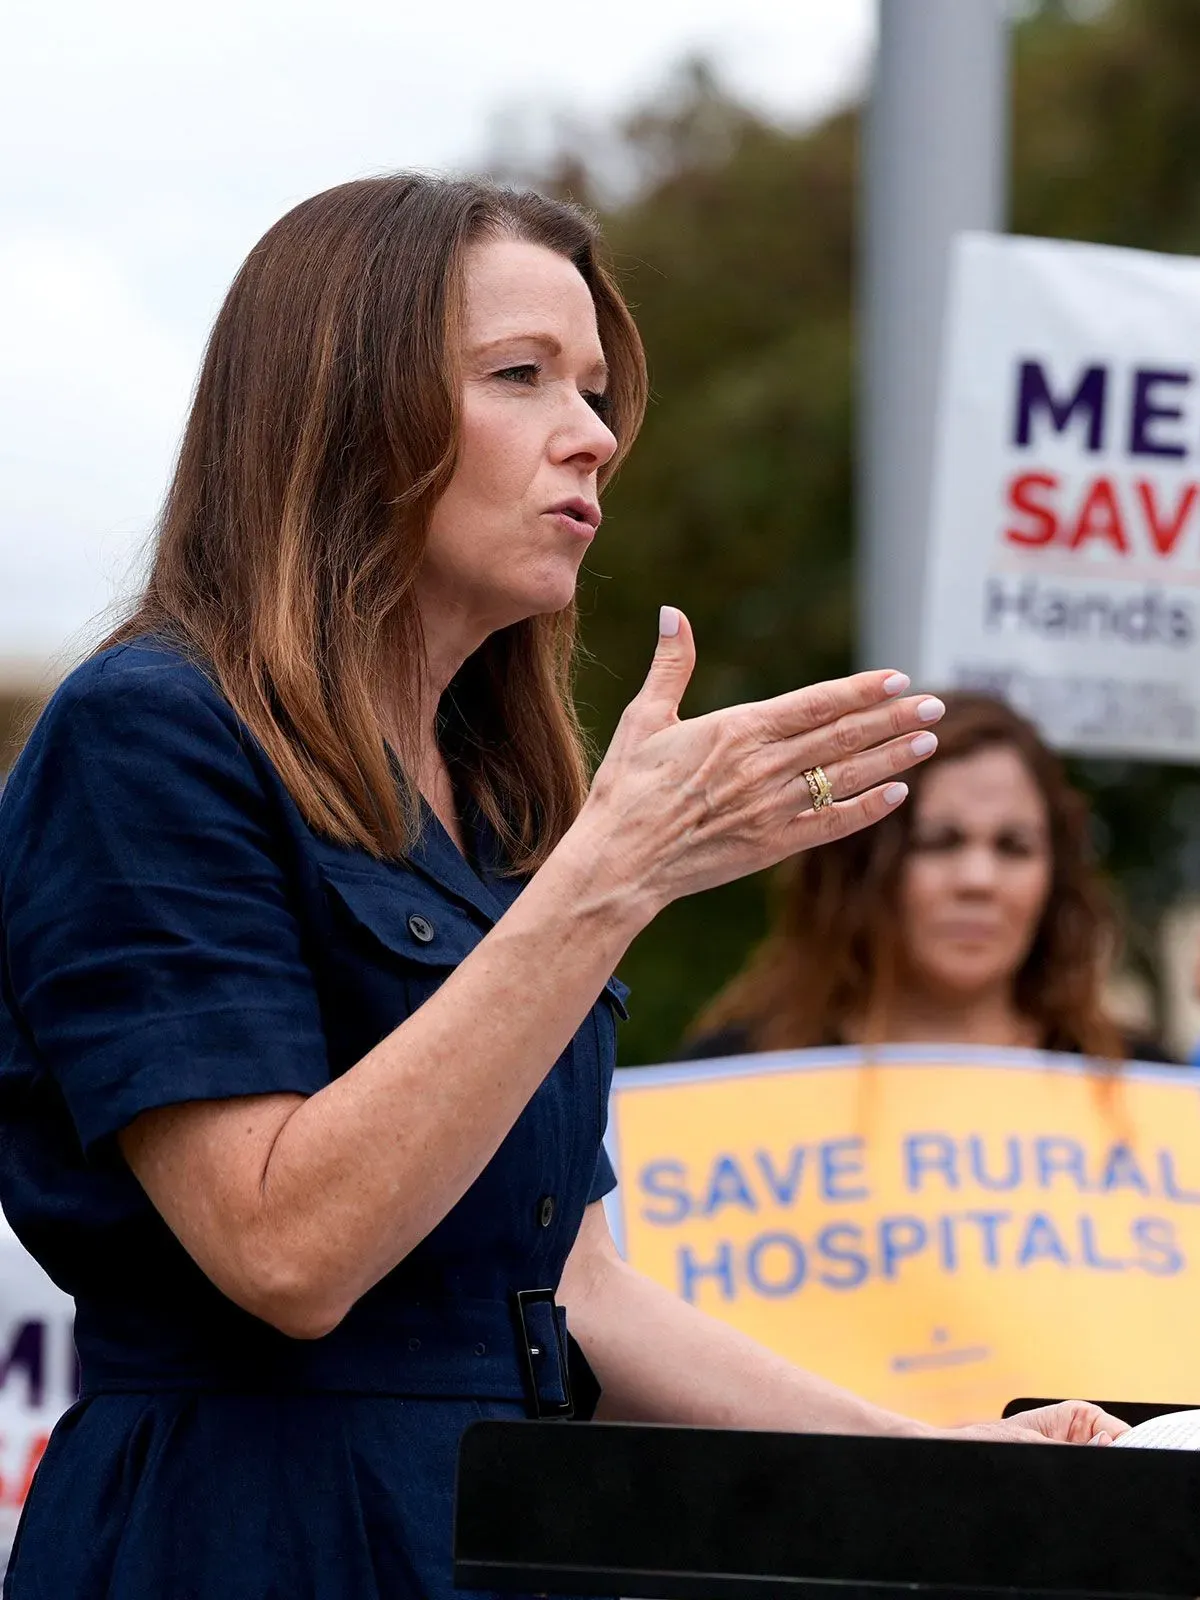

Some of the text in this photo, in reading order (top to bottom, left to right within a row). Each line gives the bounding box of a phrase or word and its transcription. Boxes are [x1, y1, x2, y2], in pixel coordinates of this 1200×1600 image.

[984, 580, 1193, 650] Hands
[640, 1137, 868, 1225] SAVE
[679, 1207, 1184, 1303] HOSPITALS
